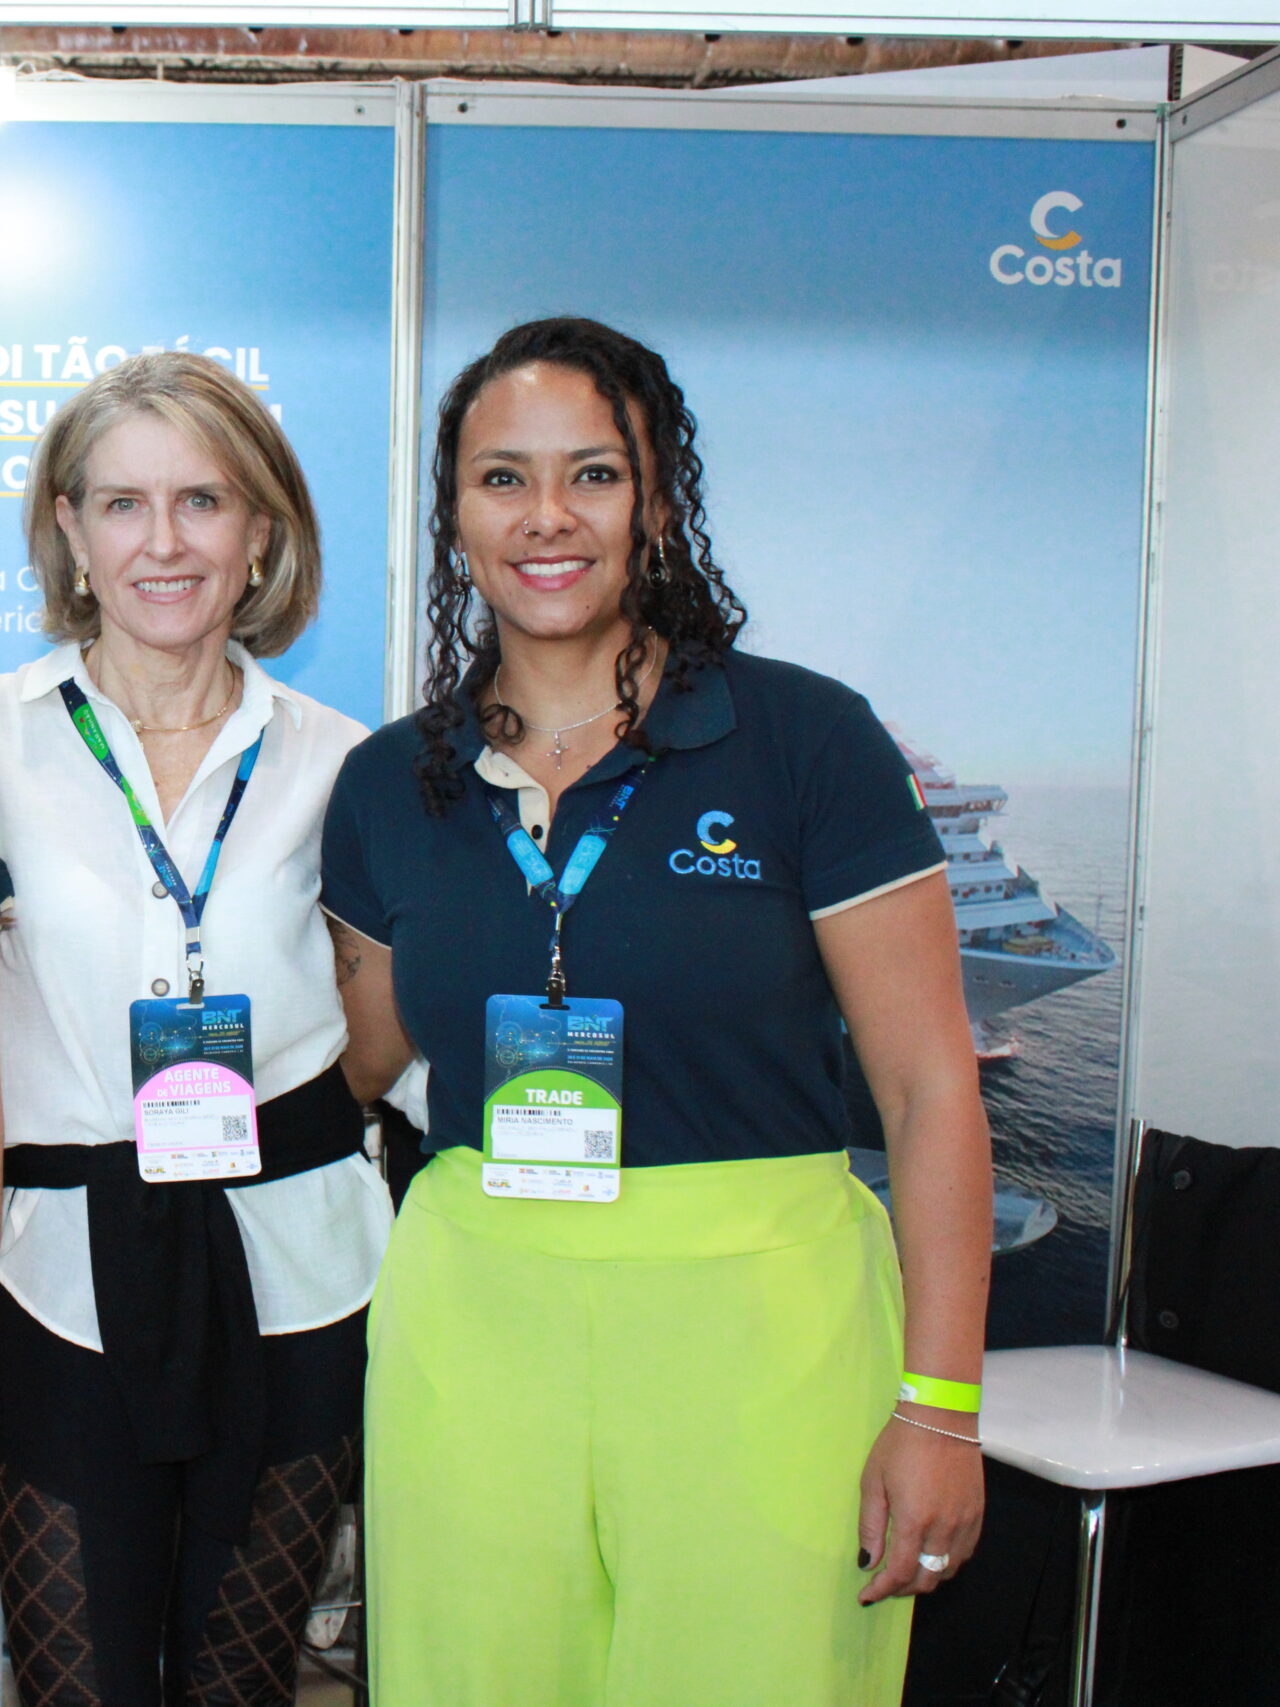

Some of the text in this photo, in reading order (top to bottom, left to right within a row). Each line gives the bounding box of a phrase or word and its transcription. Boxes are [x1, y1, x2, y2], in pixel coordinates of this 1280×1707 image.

[990, 244, 1122, 287] Costa
[668, 848, 762, 880] Costa
[202, 1009, 242, 1025] BNT
[567, 1015, 614, 1032] BNT
[202, 1023, 245, 1031] MERCOSUL
[567, 1031, 616, 1039] MERCOSUL
[164, 1068, 219, 1083] AGENTE
[157, 1080, 232, 1097] DE VIAGENS
[525, 1088, 583, 1106] TRADE
[521, 1117, 573, 1126] NASCIMENTO
